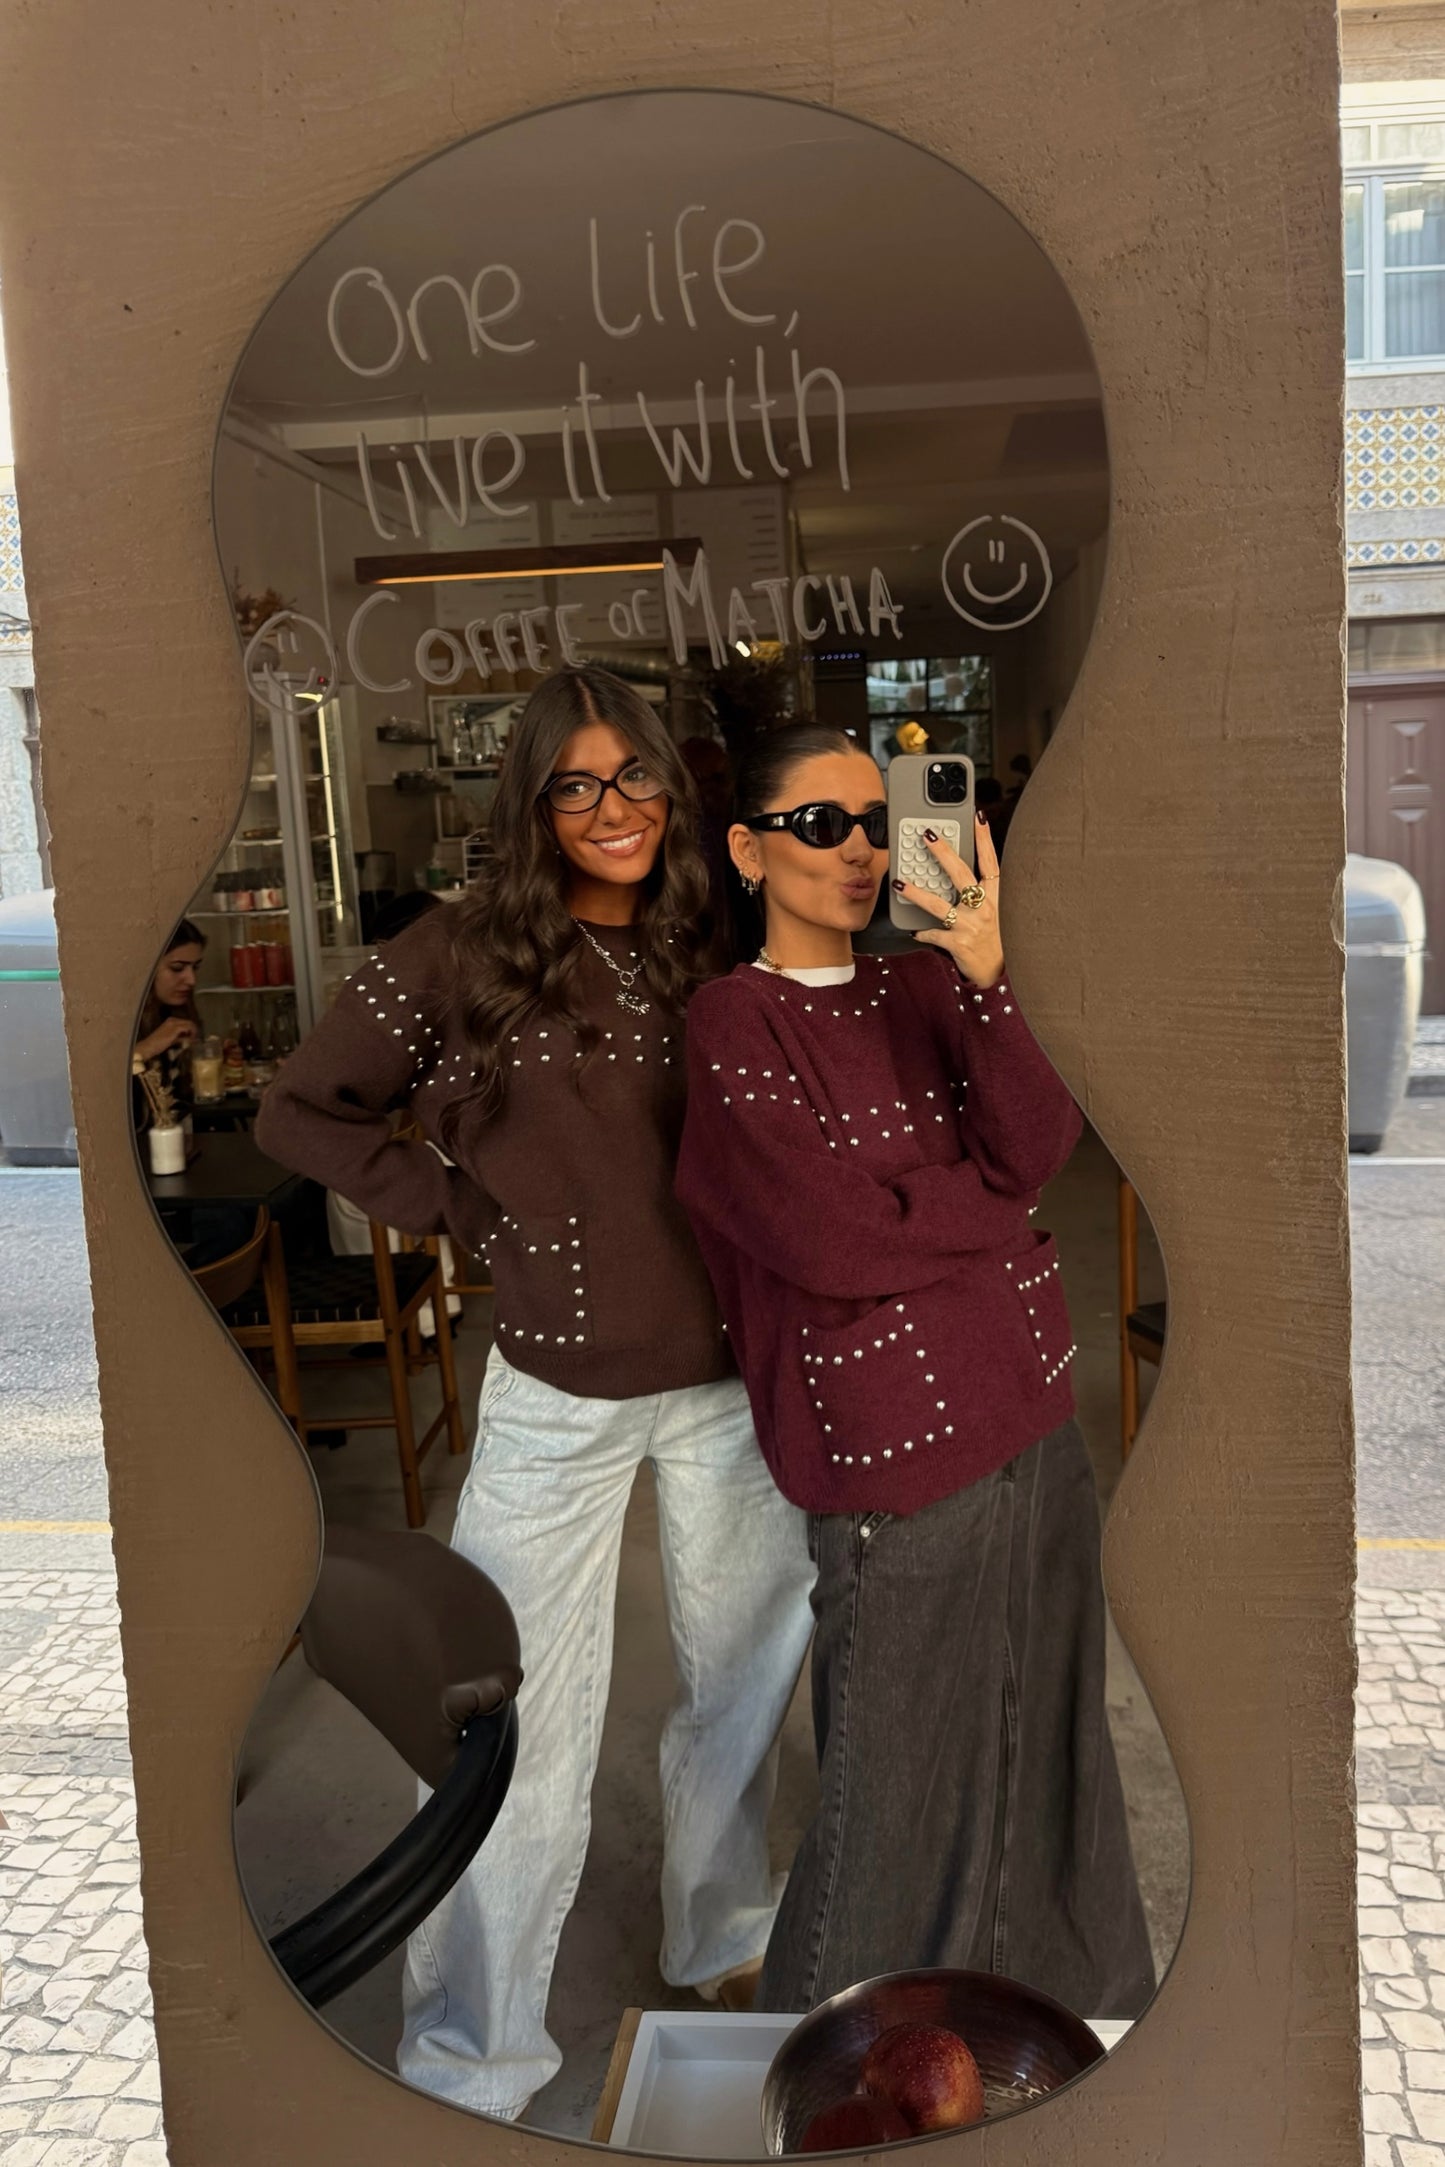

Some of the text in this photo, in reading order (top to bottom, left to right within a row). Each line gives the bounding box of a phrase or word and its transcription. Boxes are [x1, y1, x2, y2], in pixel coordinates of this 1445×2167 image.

[328, 264, 536, 377] One
[561, 361, 612, 506] it
[637, 345, 851, 492] with
[663, 546, 904, 672] MATCHA
